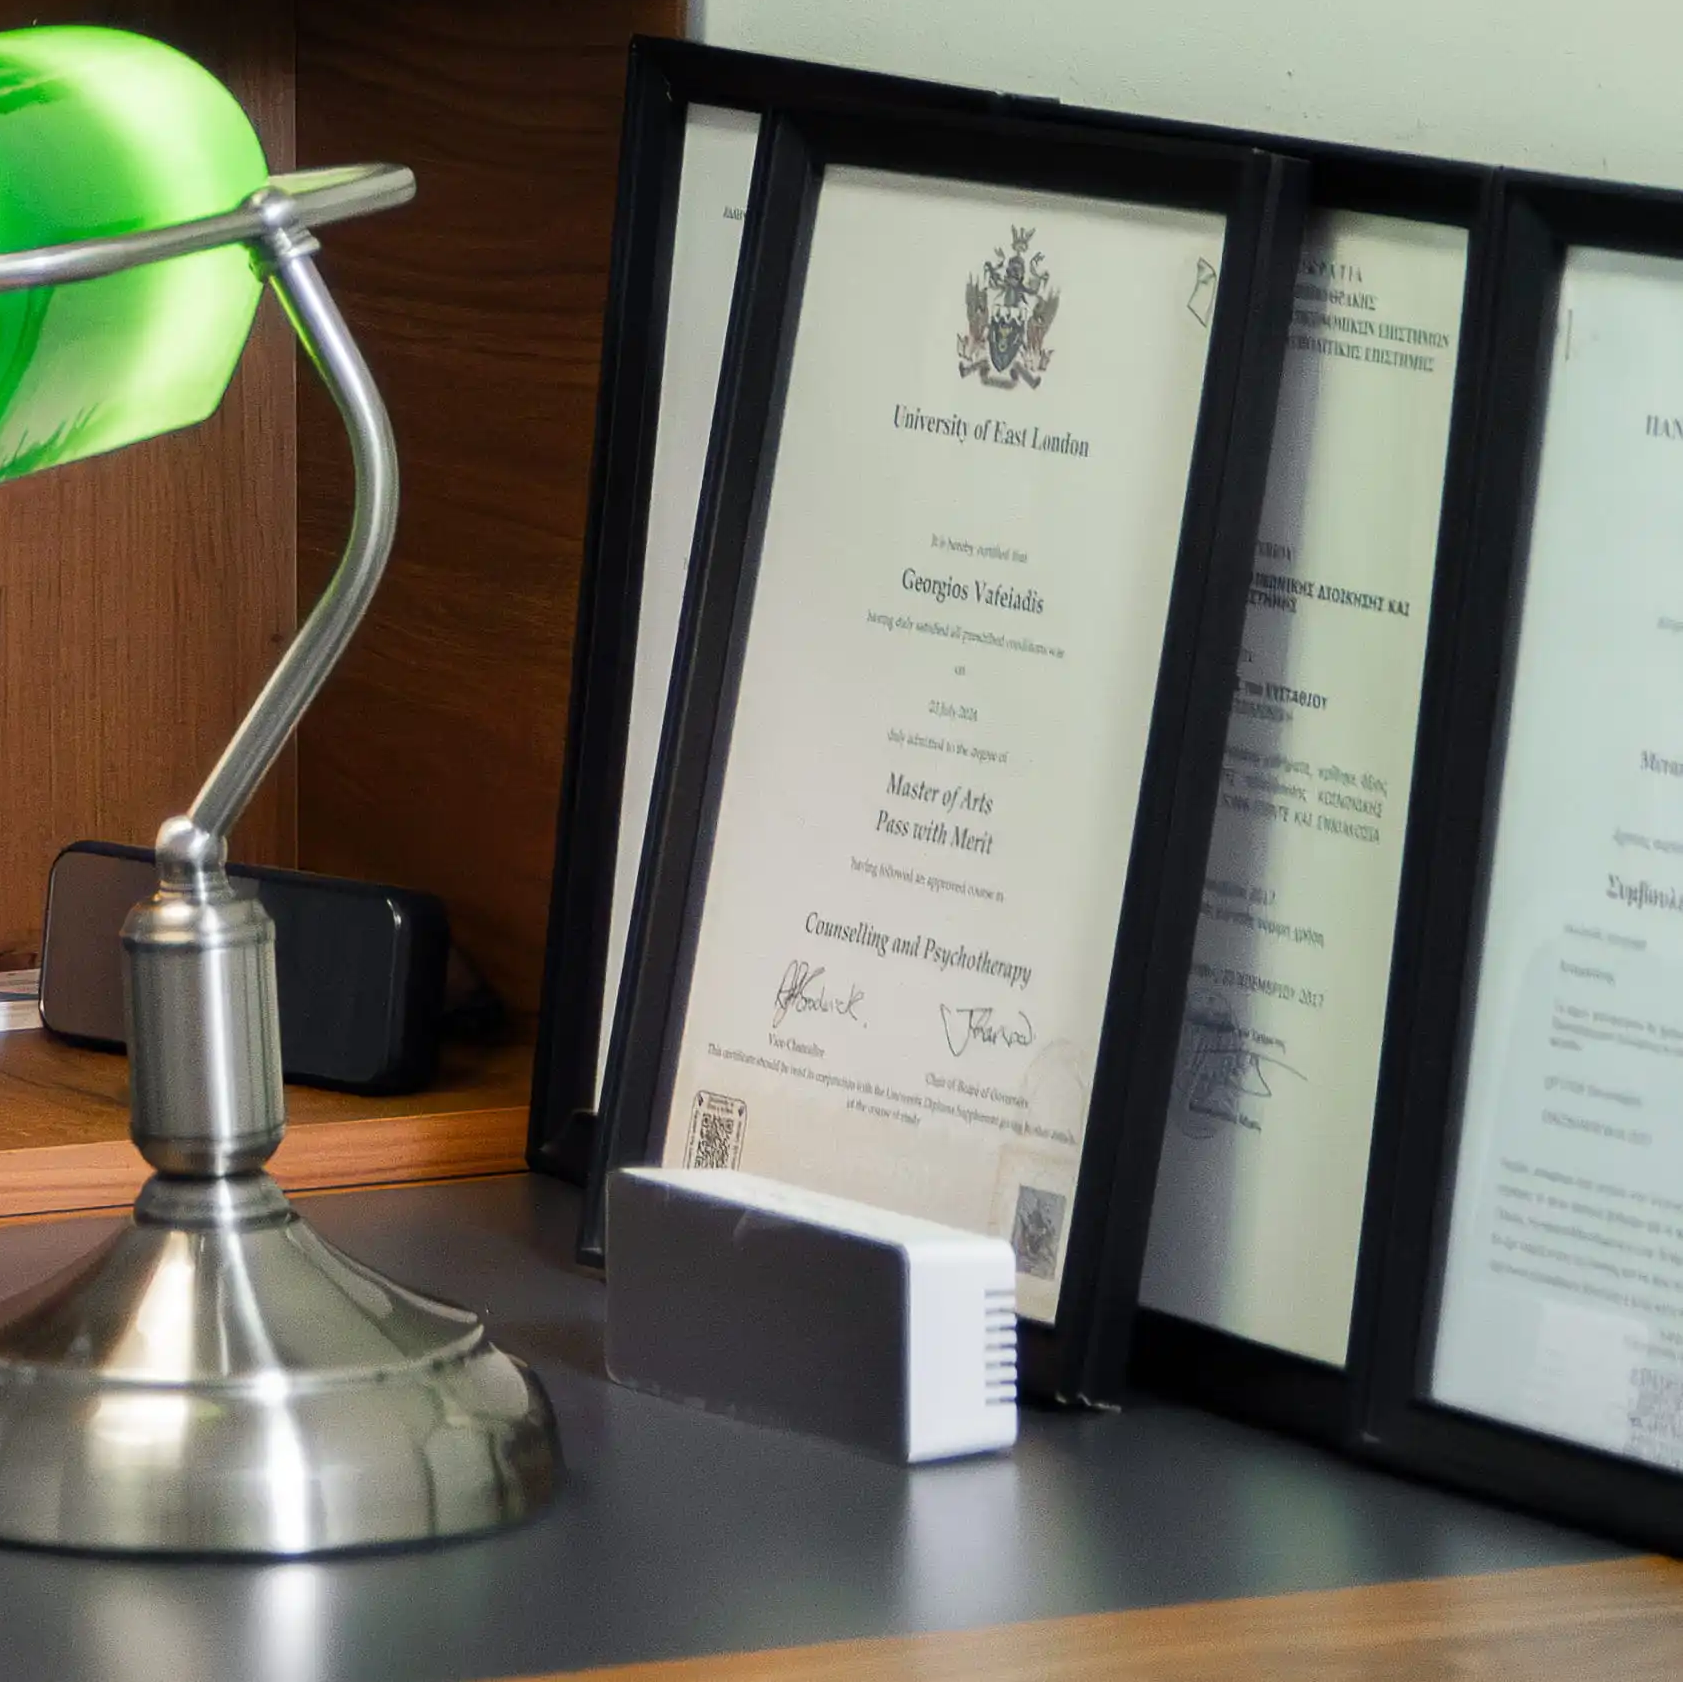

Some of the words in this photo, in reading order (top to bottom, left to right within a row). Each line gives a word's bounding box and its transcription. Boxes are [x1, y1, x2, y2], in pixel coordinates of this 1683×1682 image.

[1378, 321, 1450, 349] ΕΠΙΣΤΗΜΩΝ
[1364, 346, 1436, 373] ΕΠΙΣΤΗΜΗΣ
[893, 403, 968, 443] University
[974, 419, 992, 442] of
[994, 420, 1027, 448] East
[1031, 426, 1089, 458] London
[902, 567, 968, 603] Georgios
[974, 579, 1044, 614] Vafeiadis
[1317, 584, 1385, 613] ΔΙΟΙΚΗΣΗΣ
[1388, 599, 1410, 617] ΚΑΙ
[886, 771, 940, 803] Master
[942, 785, 961, 814] of
[960, 789, 994, 815] Arts
[875, 809, 910, 837] Pass
[912, 818, 948, 846] with
[950, 825, 993, 855] Merit
[805, 911, 889, 958] Counselling
[891, 934, 922, 958] and
[923, 937, 1032, 990] Psychotherapy
